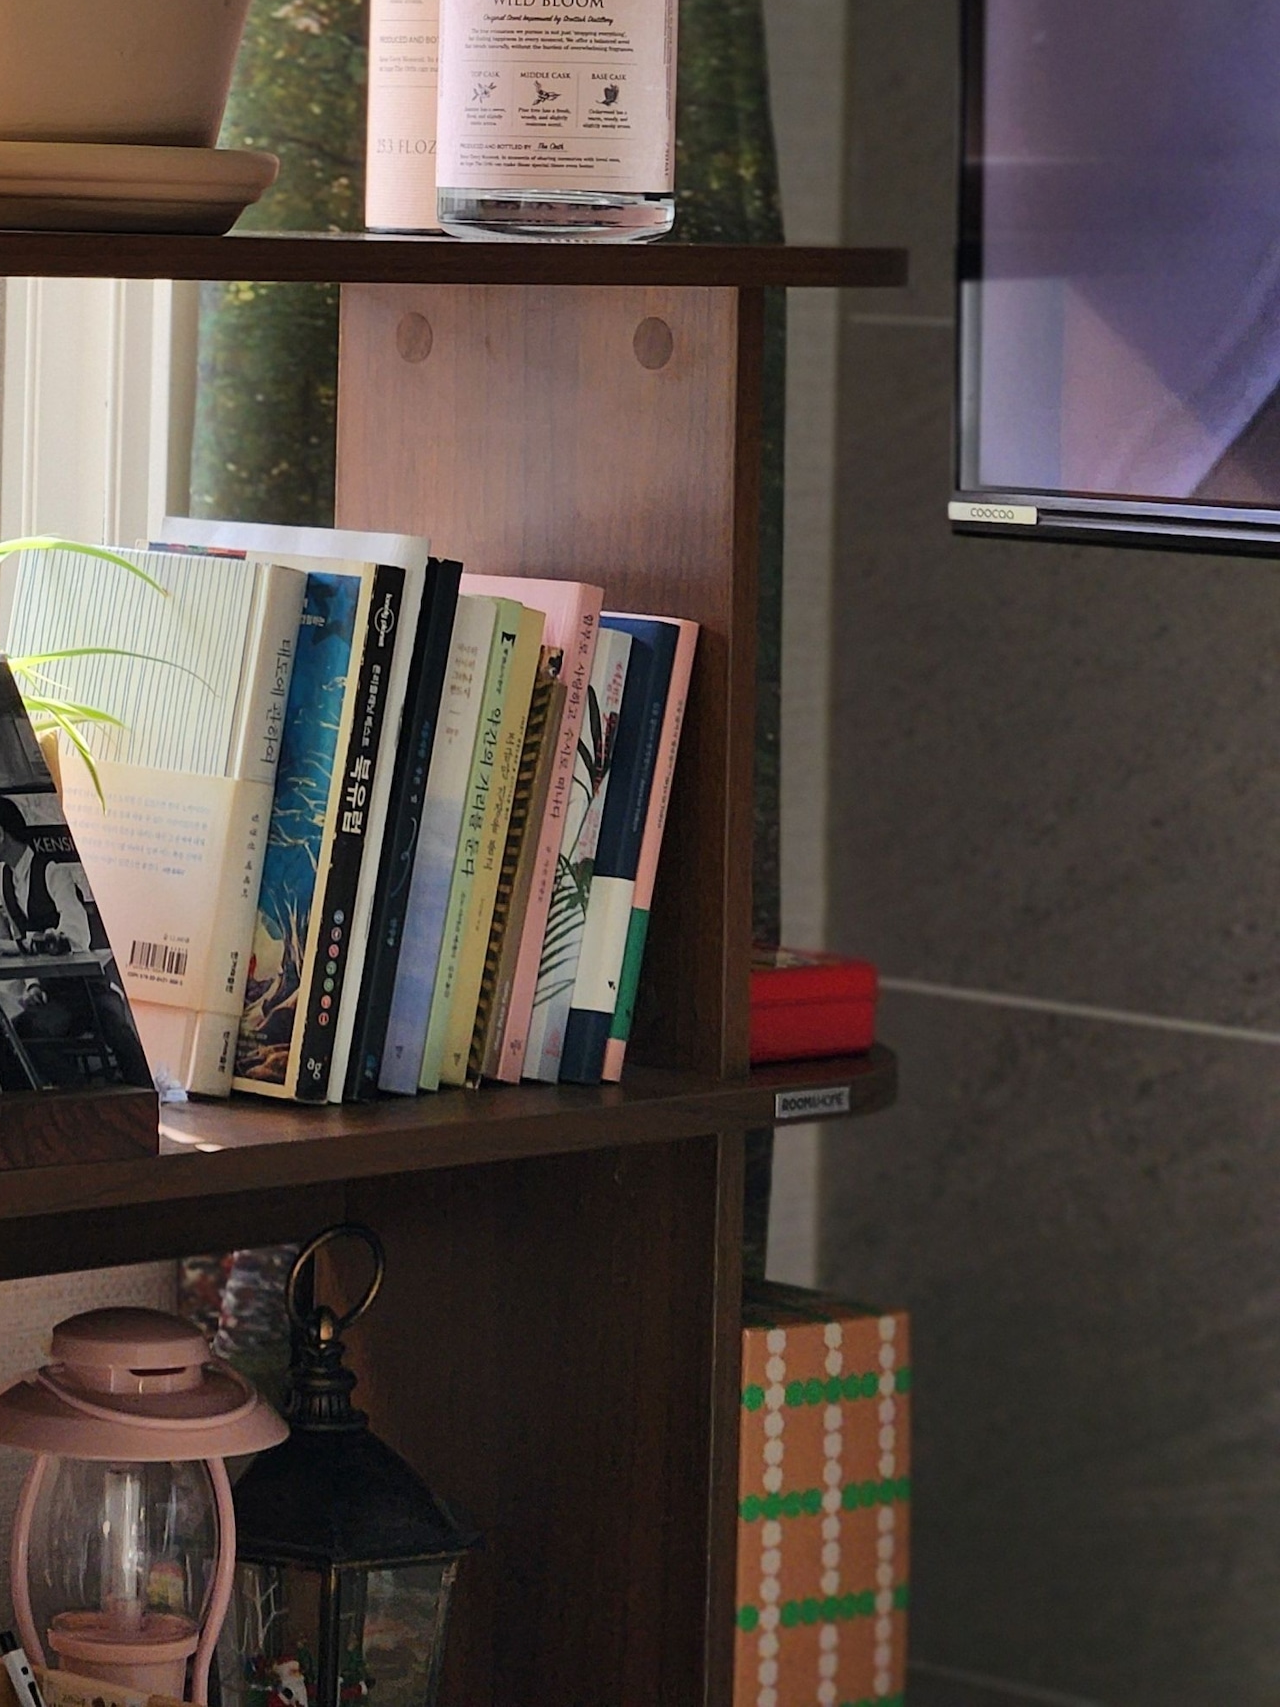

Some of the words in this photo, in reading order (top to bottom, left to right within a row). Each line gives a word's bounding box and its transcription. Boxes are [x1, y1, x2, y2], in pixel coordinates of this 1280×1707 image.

[520, 71, 550, 79] MIDDLE
[551, 72, 571, 80] CASK
[591, 73, 608, 81] BASE
[269, 639, 291, 696] 태도에
[260, 707, 283, 765] 관하여
[479, 708, 501, 766] 약간의
[341, 755, 372, 834] 북유럽
[469, 772, 490, 830] 거리를
[460, 838, 481, 878] 둔다
